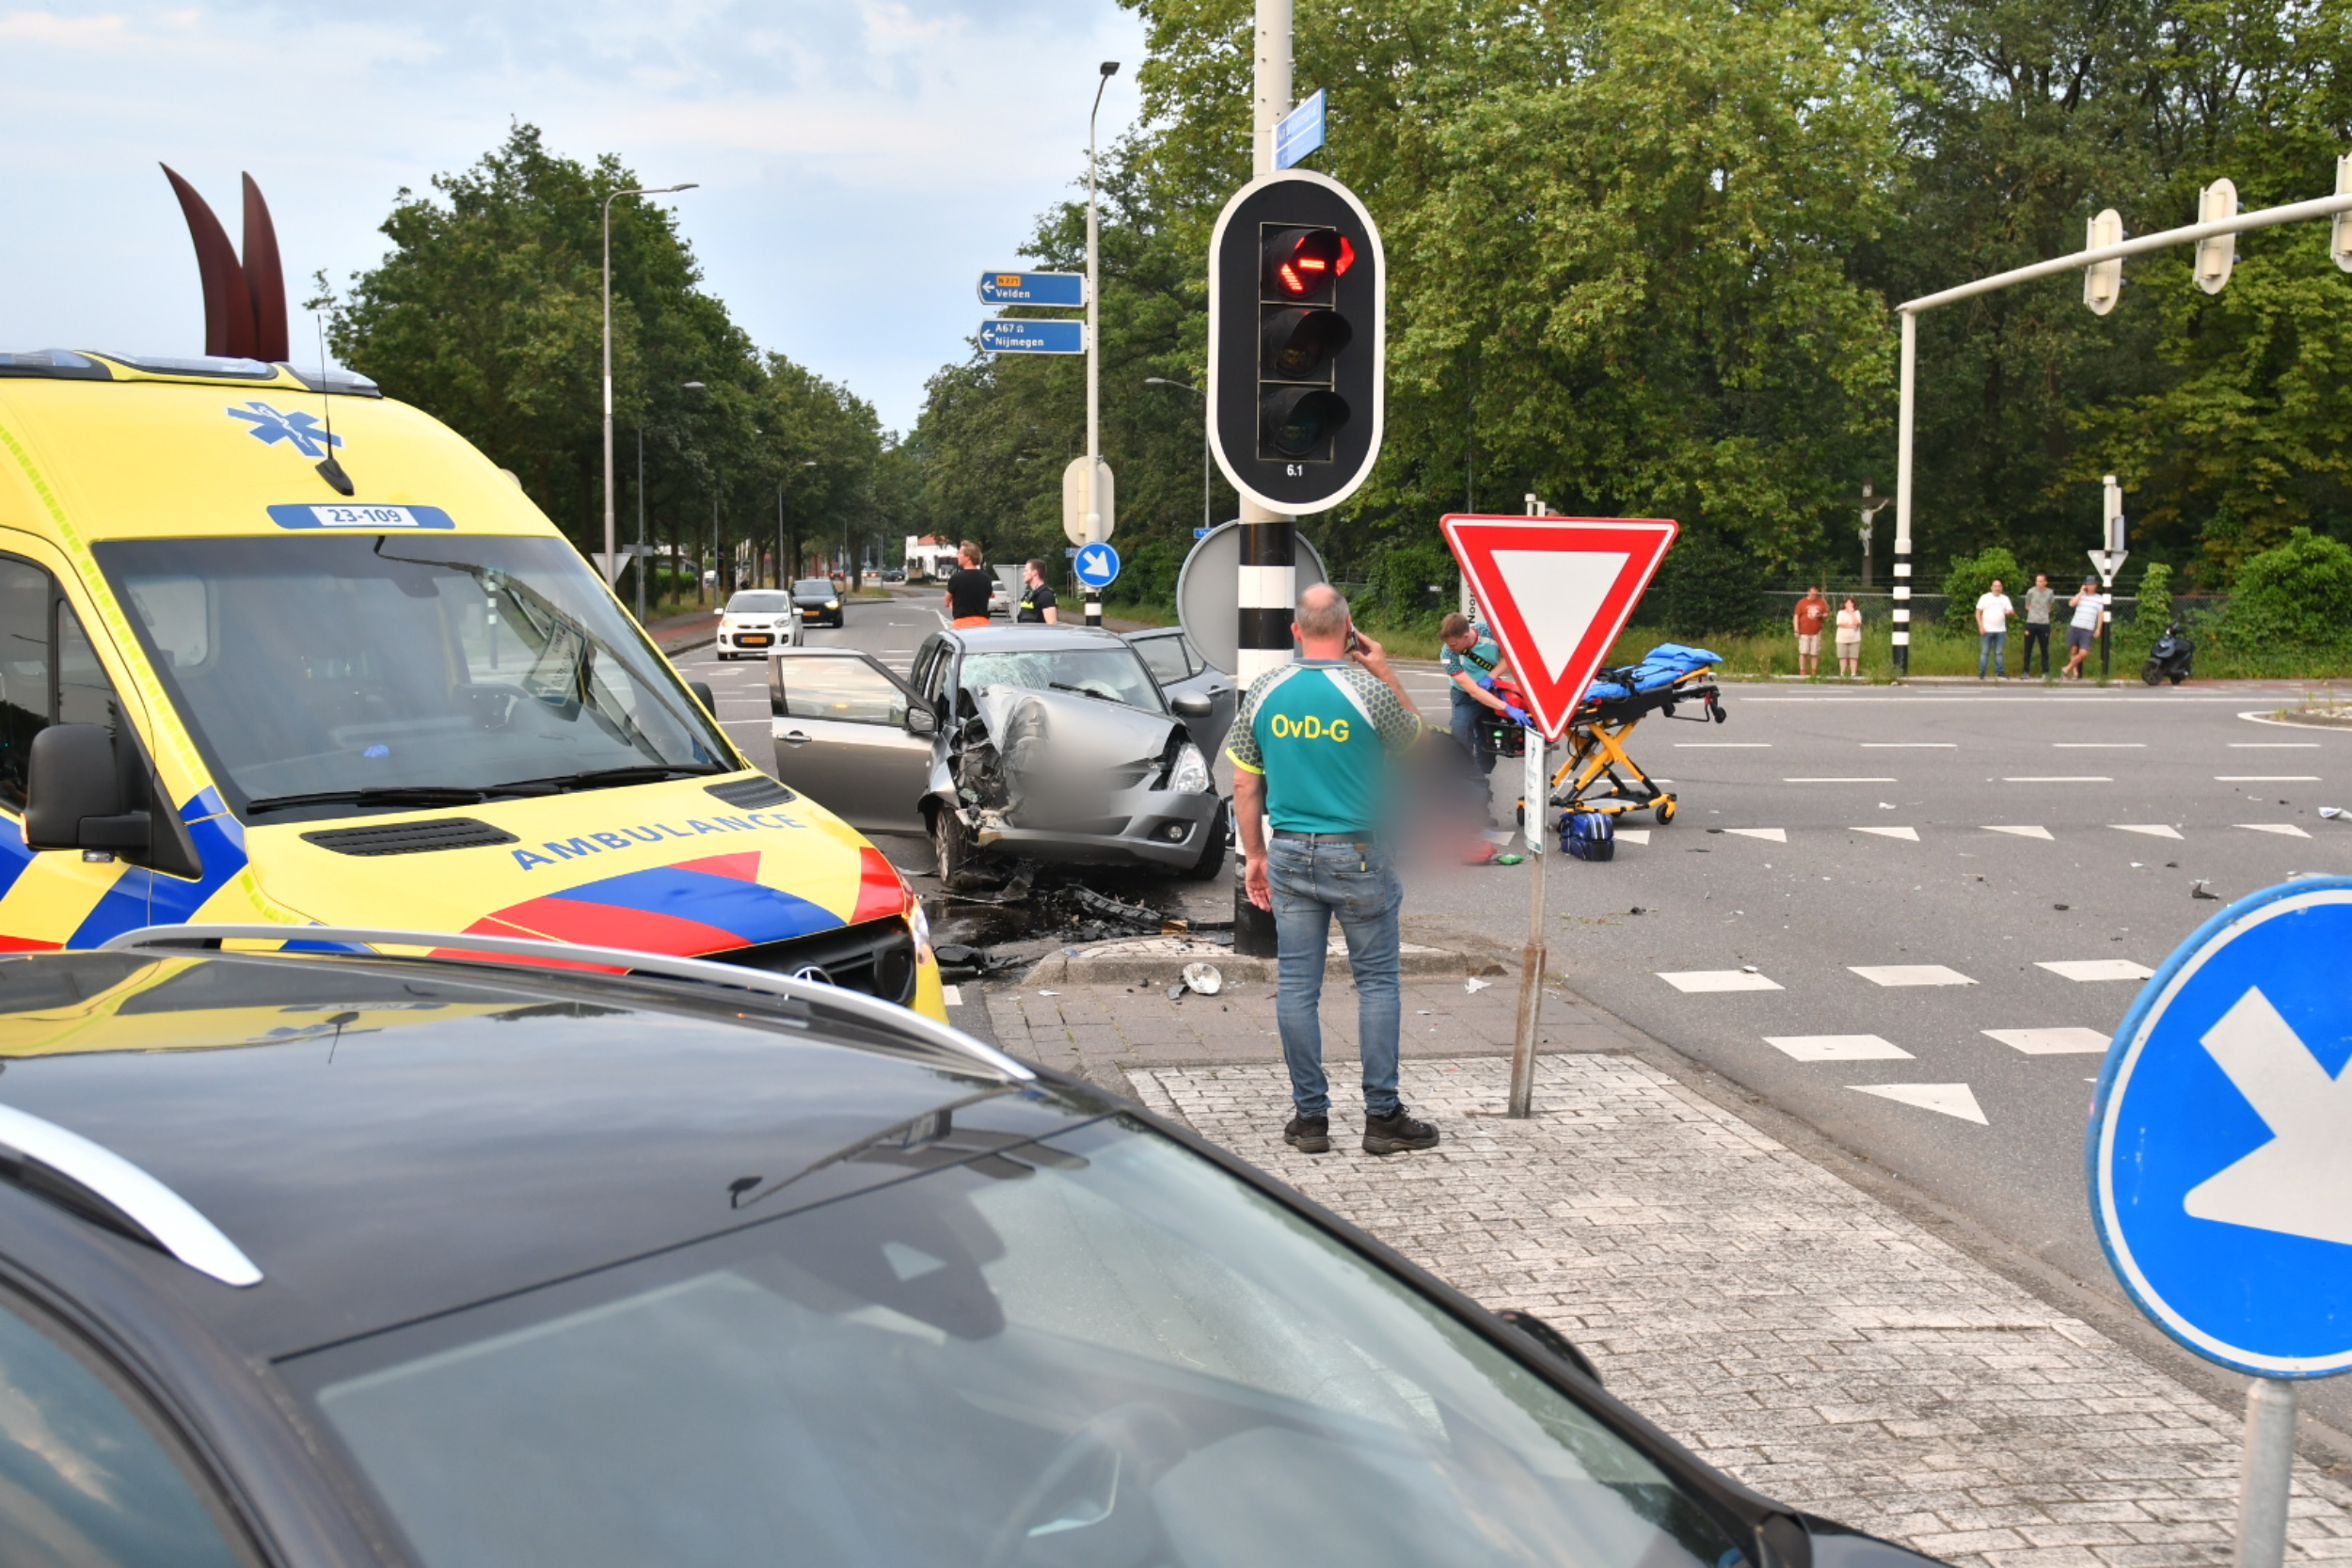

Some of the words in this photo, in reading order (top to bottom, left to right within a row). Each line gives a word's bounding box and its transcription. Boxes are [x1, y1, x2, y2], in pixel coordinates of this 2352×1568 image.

[995, 289, 1030, 298] Velden
[995, 324, 1014, 333] A67
[995, 337, 1044, 348] Nijmegen
[1286, 464, 1304, 477] 6.1
[326, 509, 403, 522] 23-109
[1271, 713, 1350, 743] OvD-G
[510, 813, 807, 872] AMBULANCE
